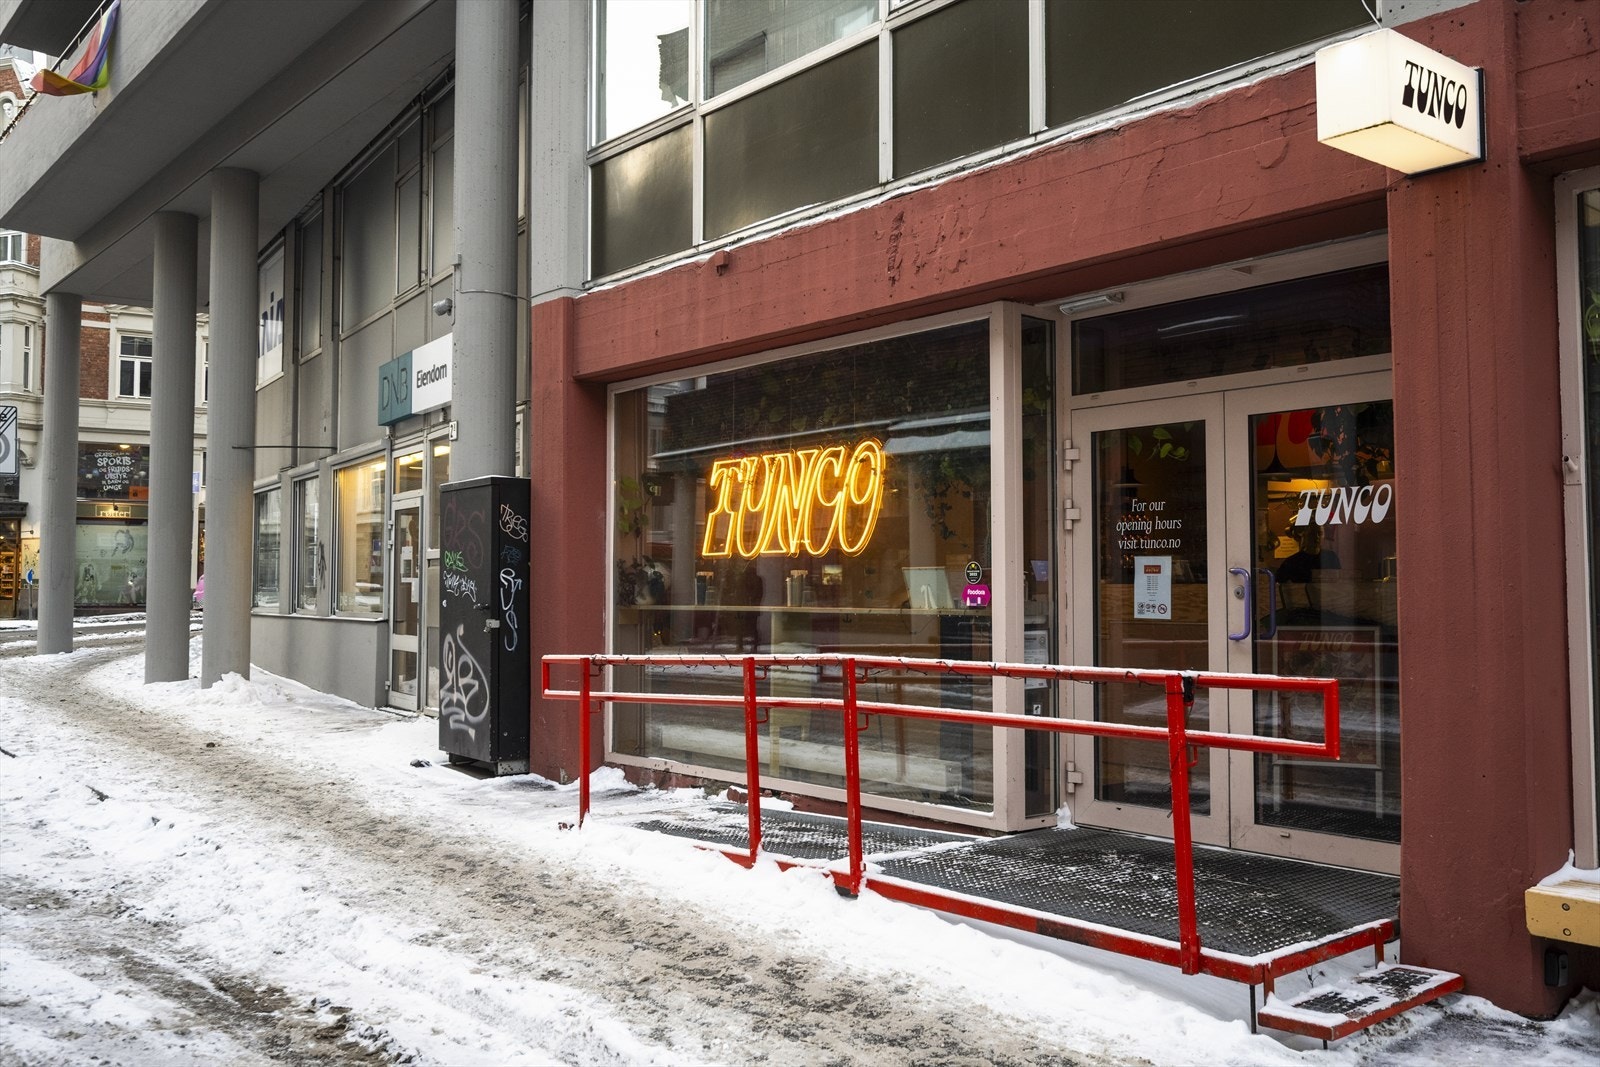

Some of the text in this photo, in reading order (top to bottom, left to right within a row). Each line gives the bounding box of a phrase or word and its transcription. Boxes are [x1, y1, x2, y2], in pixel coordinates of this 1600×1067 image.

[1402, 60, 1467, 129] TUNCO
[382, 367, 408, 411] DNB
[416, 363, 448, 389] Eiendom
[702, 437, 886, 560] TUNCO
[1131, 498, 1166, 512] For our
[1295, 483, 1393, 526] TUNCO
[1116, 515, 1182, 536] opening hours
[1118, 538, 1181, 550] visit tunco.no
